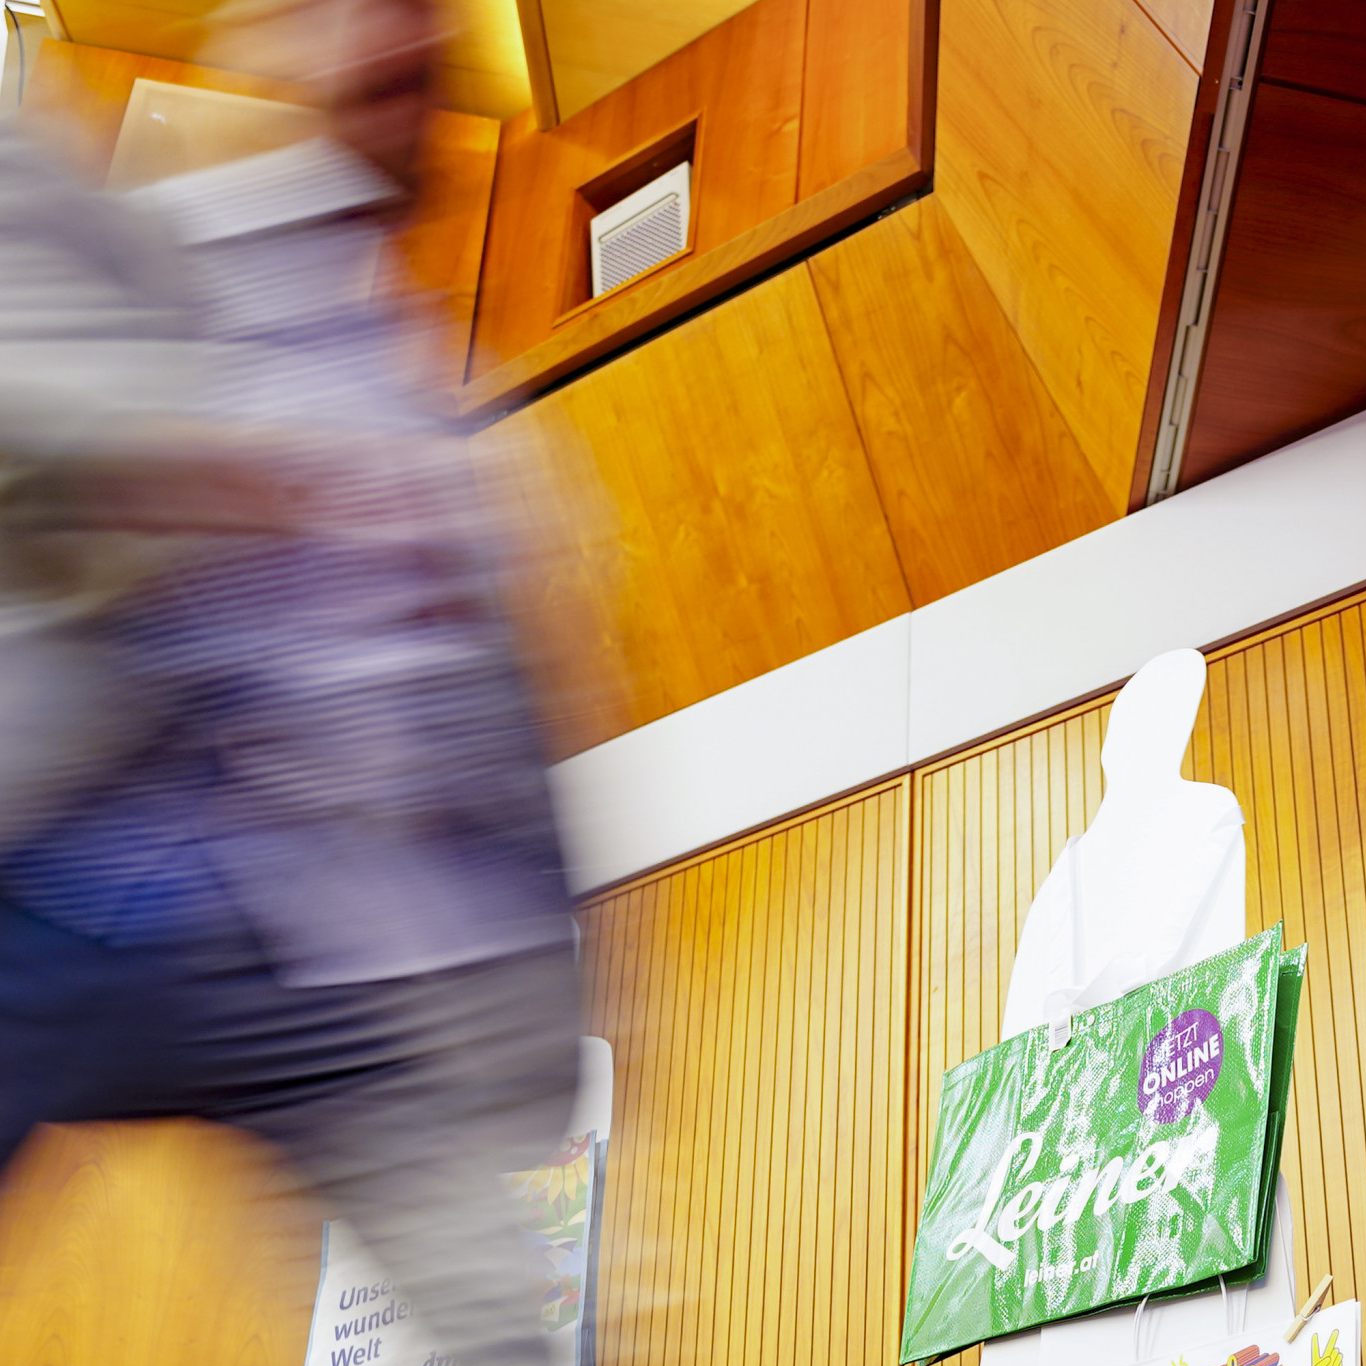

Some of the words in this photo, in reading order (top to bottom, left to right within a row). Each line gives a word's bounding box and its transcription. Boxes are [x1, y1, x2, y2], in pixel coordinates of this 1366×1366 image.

[1143, 1034, 1220, 1094] ONLINE
[947, 1131, 1217, 1270] Leiner
[339, 1278, 396, 1310] Unse
